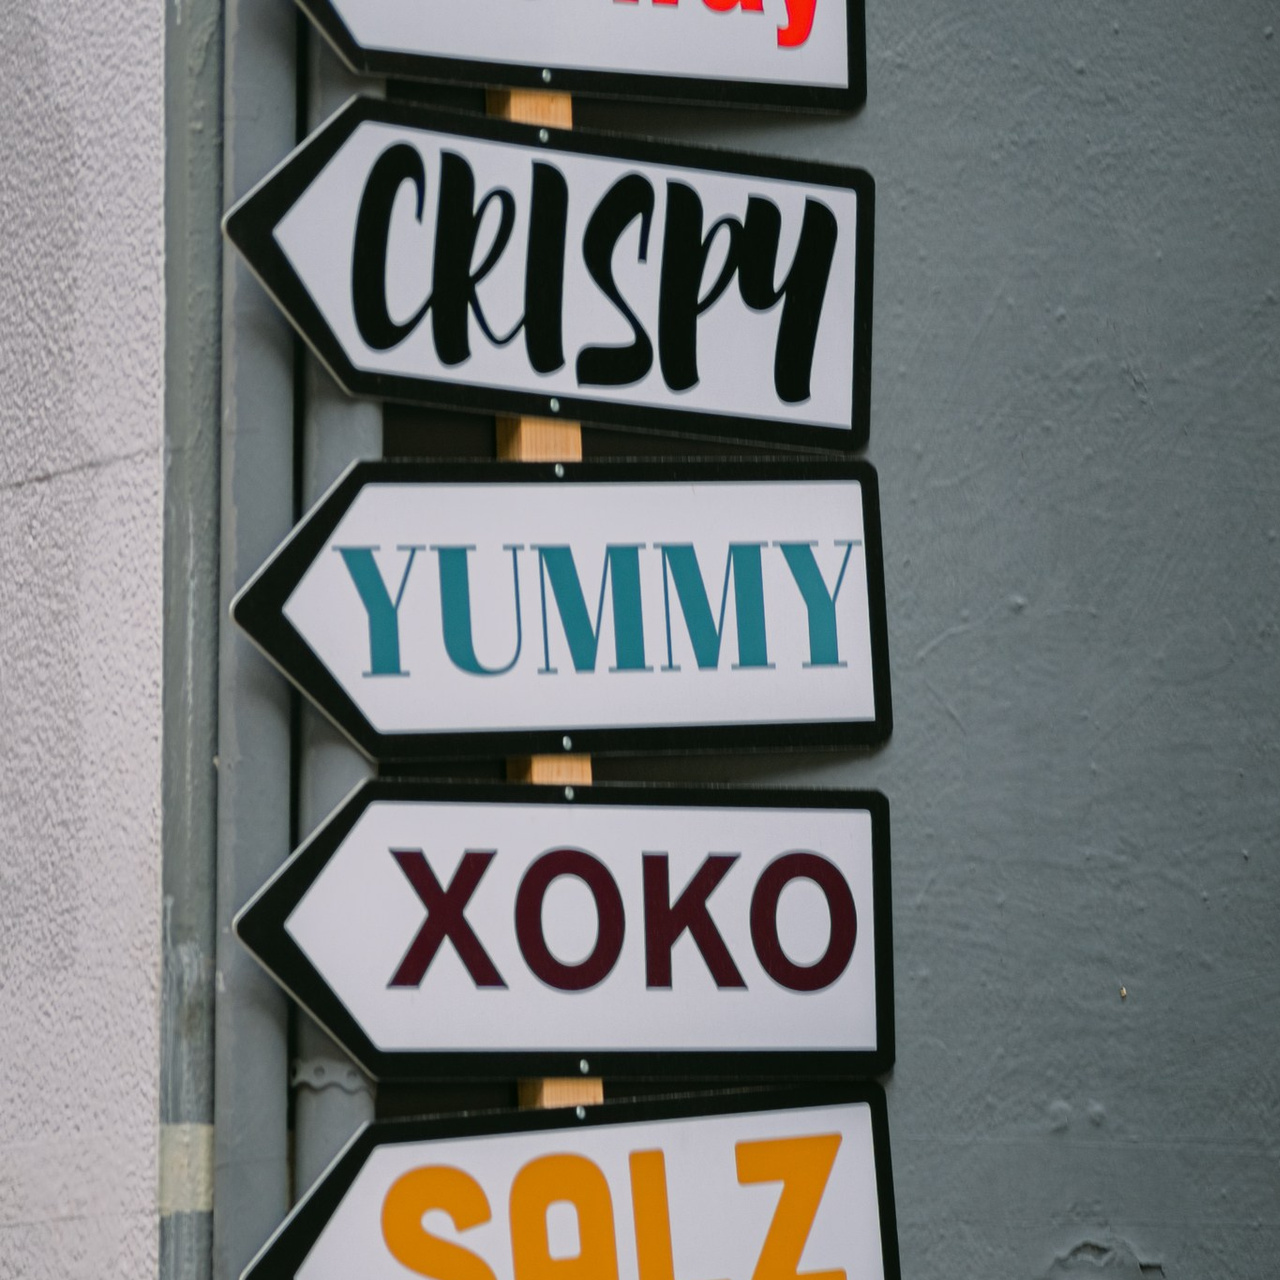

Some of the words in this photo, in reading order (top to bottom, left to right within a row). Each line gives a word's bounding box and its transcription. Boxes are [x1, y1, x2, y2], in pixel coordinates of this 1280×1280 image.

[350, 142, 839, 405] CRISPY
[331, 539, 862, 677] YUMMY
[386, 846, 858, 993] XOKO
